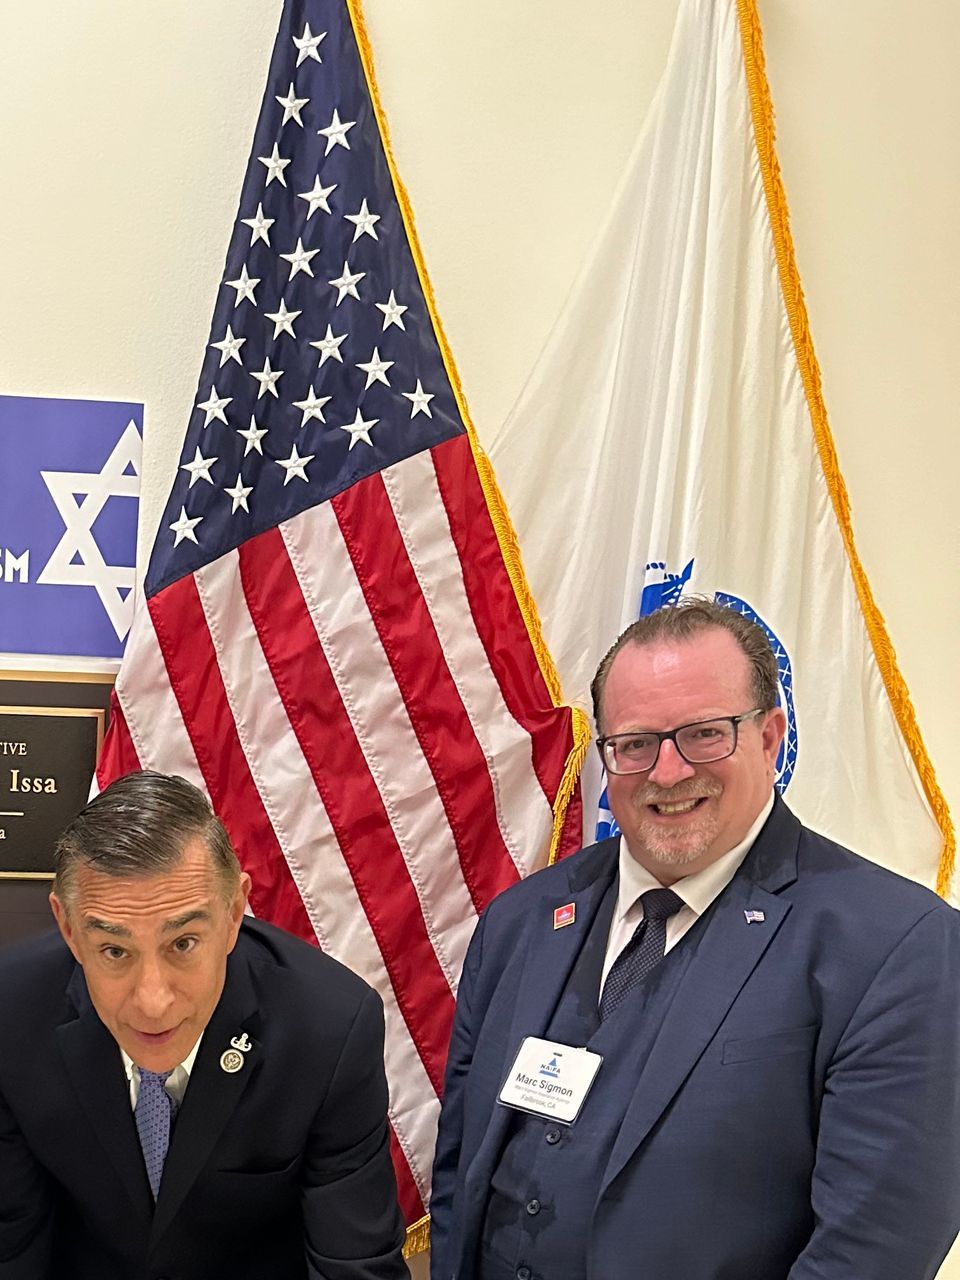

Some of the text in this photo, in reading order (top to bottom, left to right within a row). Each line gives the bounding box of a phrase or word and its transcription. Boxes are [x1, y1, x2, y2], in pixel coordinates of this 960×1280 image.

[10, 769, 57, 794] Issa
[516, 1073, 538, 1087] Marc
[539, 1079, 573, 1097] Sigmon
